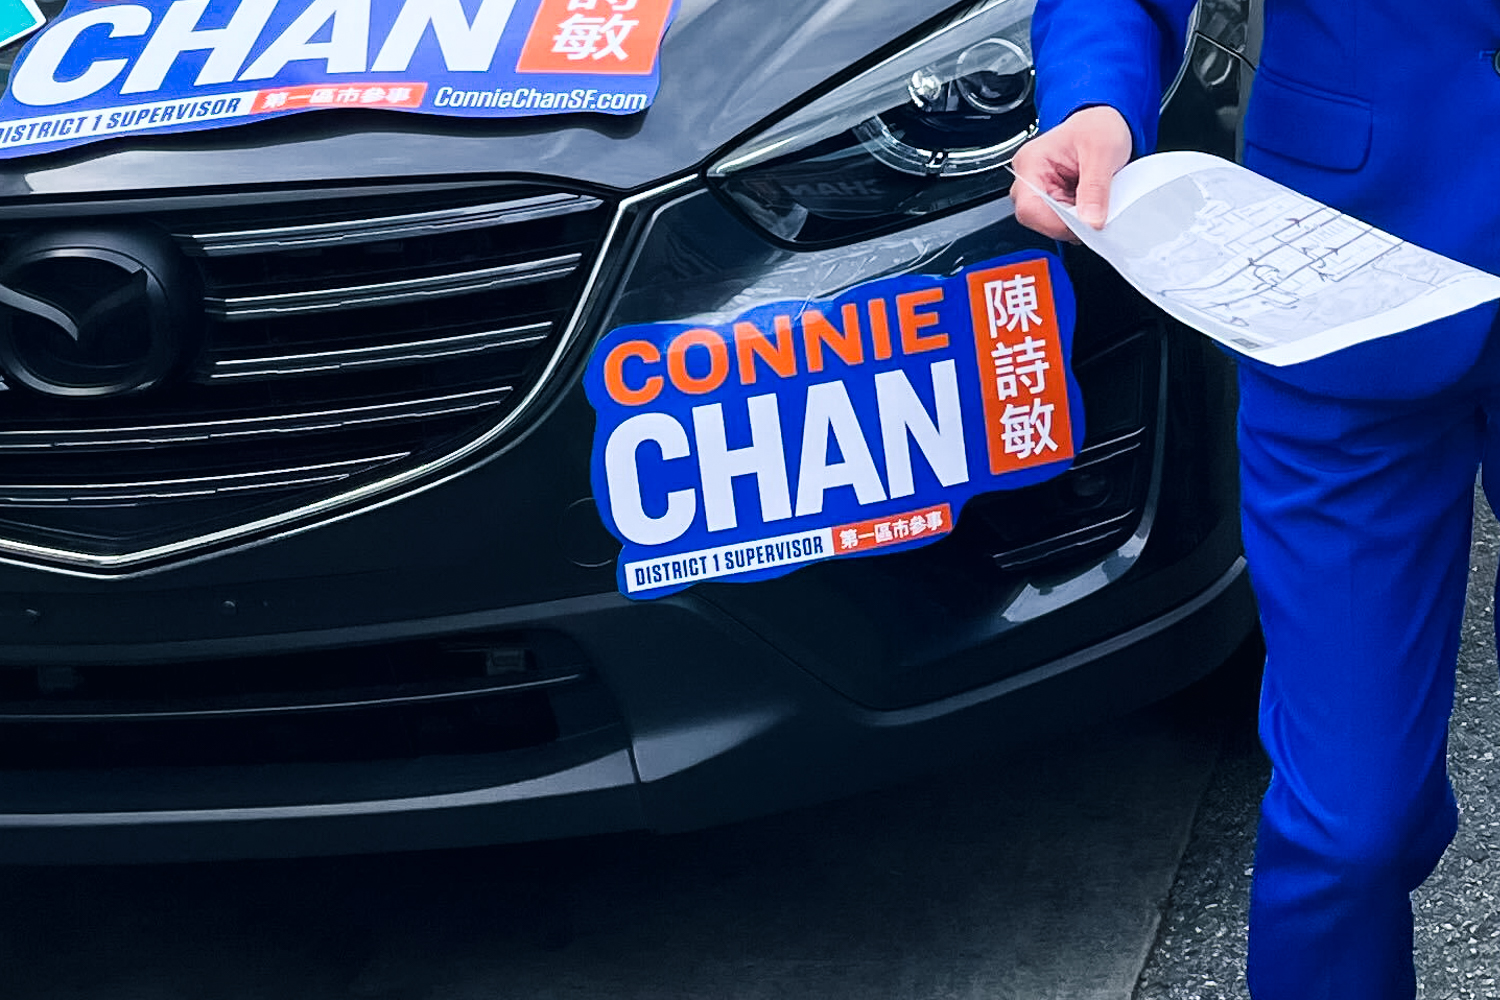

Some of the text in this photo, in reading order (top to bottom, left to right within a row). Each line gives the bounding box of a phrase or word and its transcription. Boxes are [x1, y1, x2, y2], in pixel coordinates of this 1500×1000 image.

[92, 114, 103, 132] 1
[106, 96, 242, 130] SUPERVISOR
[434, 86, 649, 111] ConnieChanSF.com
[603, 287, 949, 407] CONNIE
[983, 272, 1059, 461] 陳詩敏
[605, 358, 970, 546] CHAN
[838, 510, 944, 550] 第一區市參事
[634, 536, 825, 587] DISTRICT 1 SUPERVISOR
